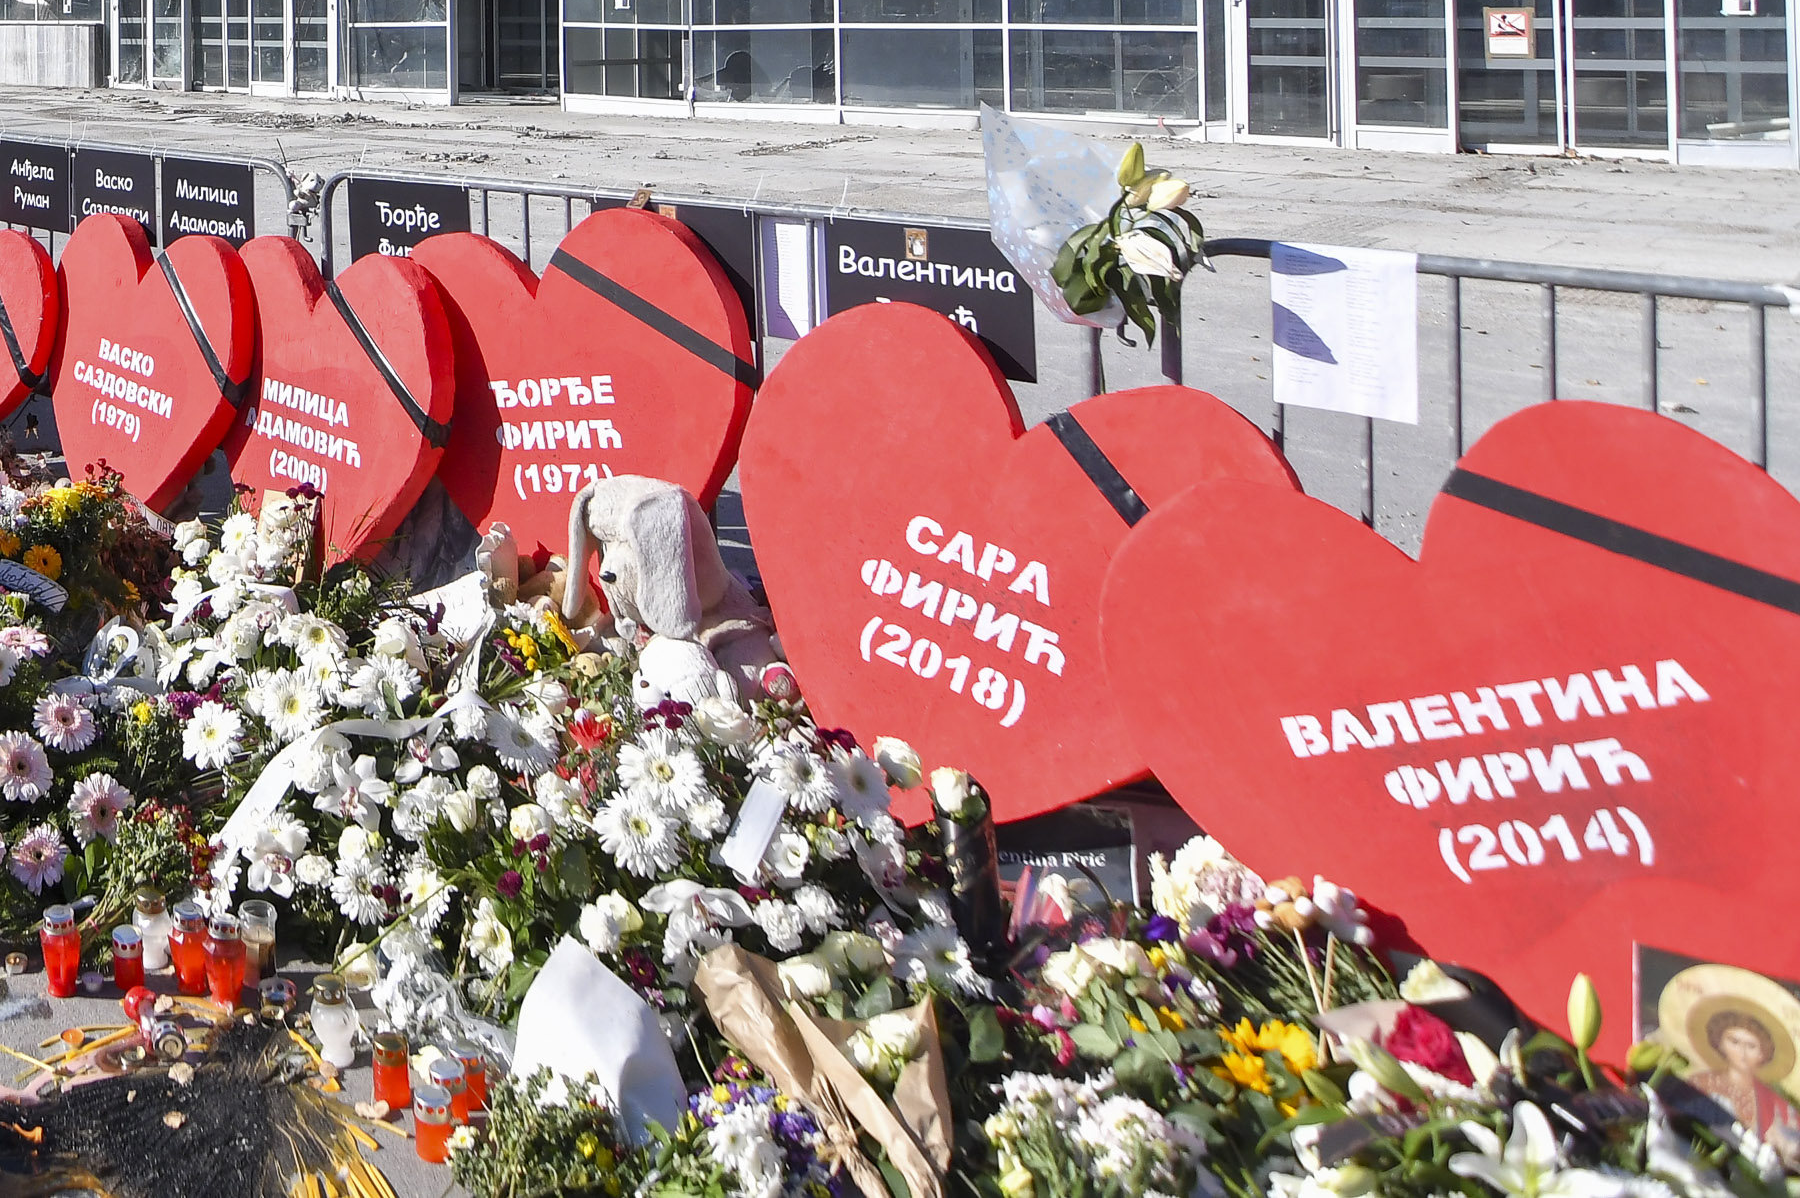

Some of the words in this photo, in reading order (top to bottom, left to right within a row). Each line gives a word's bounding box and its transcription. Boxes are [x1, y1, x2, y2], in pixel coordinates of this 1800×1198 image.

[10, 158, 55, 182] Анђела
[95, 168, 134, 193] Васко
[14, 186, 50, 210] Руман
[176, 178, 239, 207] Милица
[169, 207, 247, 242] Адамовић
[375, 199, 441, 233] Ђорђе
[838, 245, 1016, 294] Валентина
[98, 337, 155, 379] ВАСКО
[73, 366, 174, 420] САЗДОВСКИ
[262, 378, 350, 429] МИЛИЦА
[489, 375, 616, 409] ЂОРЂЕ
[90, 404, 142, 444] (1979)
[245, 408, 362, 470] АДАМОВИЋ
[495, 420, 623, 452] ФИРИЋ
[268, 448, 328, 493] (2008)
[904, 514, 1052, 607] САРА
[860, 557, 1066, 678] ФИРИЋ
[859, 615, 1026, 727] (2018)
[1280, 658, 1710, 759] ВАЛЕНТИНА
[1384, 736, 1652, 812] ФИРИЋ
[999, 851, 1058, 868] entina
[1437, 805, 1656, 884] (2014)
